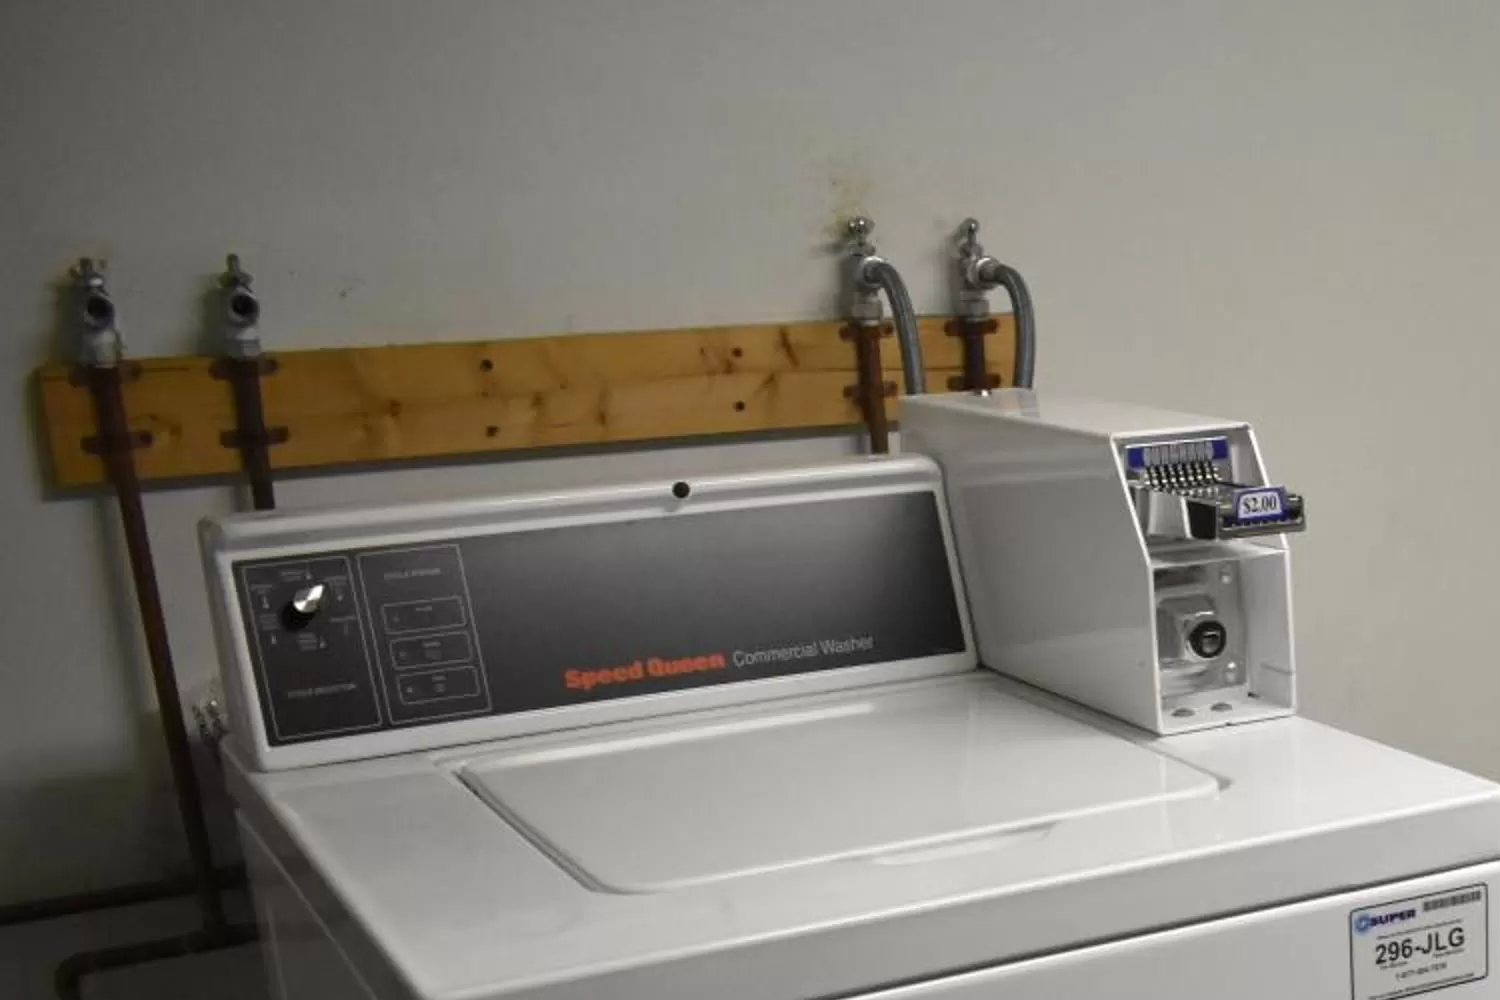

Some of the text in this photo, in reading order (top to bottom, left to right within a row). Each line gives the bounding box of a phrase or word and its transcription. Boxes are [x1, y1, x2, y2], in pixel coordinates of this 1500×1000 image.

[1243, 495, 1277, 514] $2.00
[565, 635, 874, 691] Speed Queen Commercial Washer
[1375, 926, 1465, 965] 296-JLG
